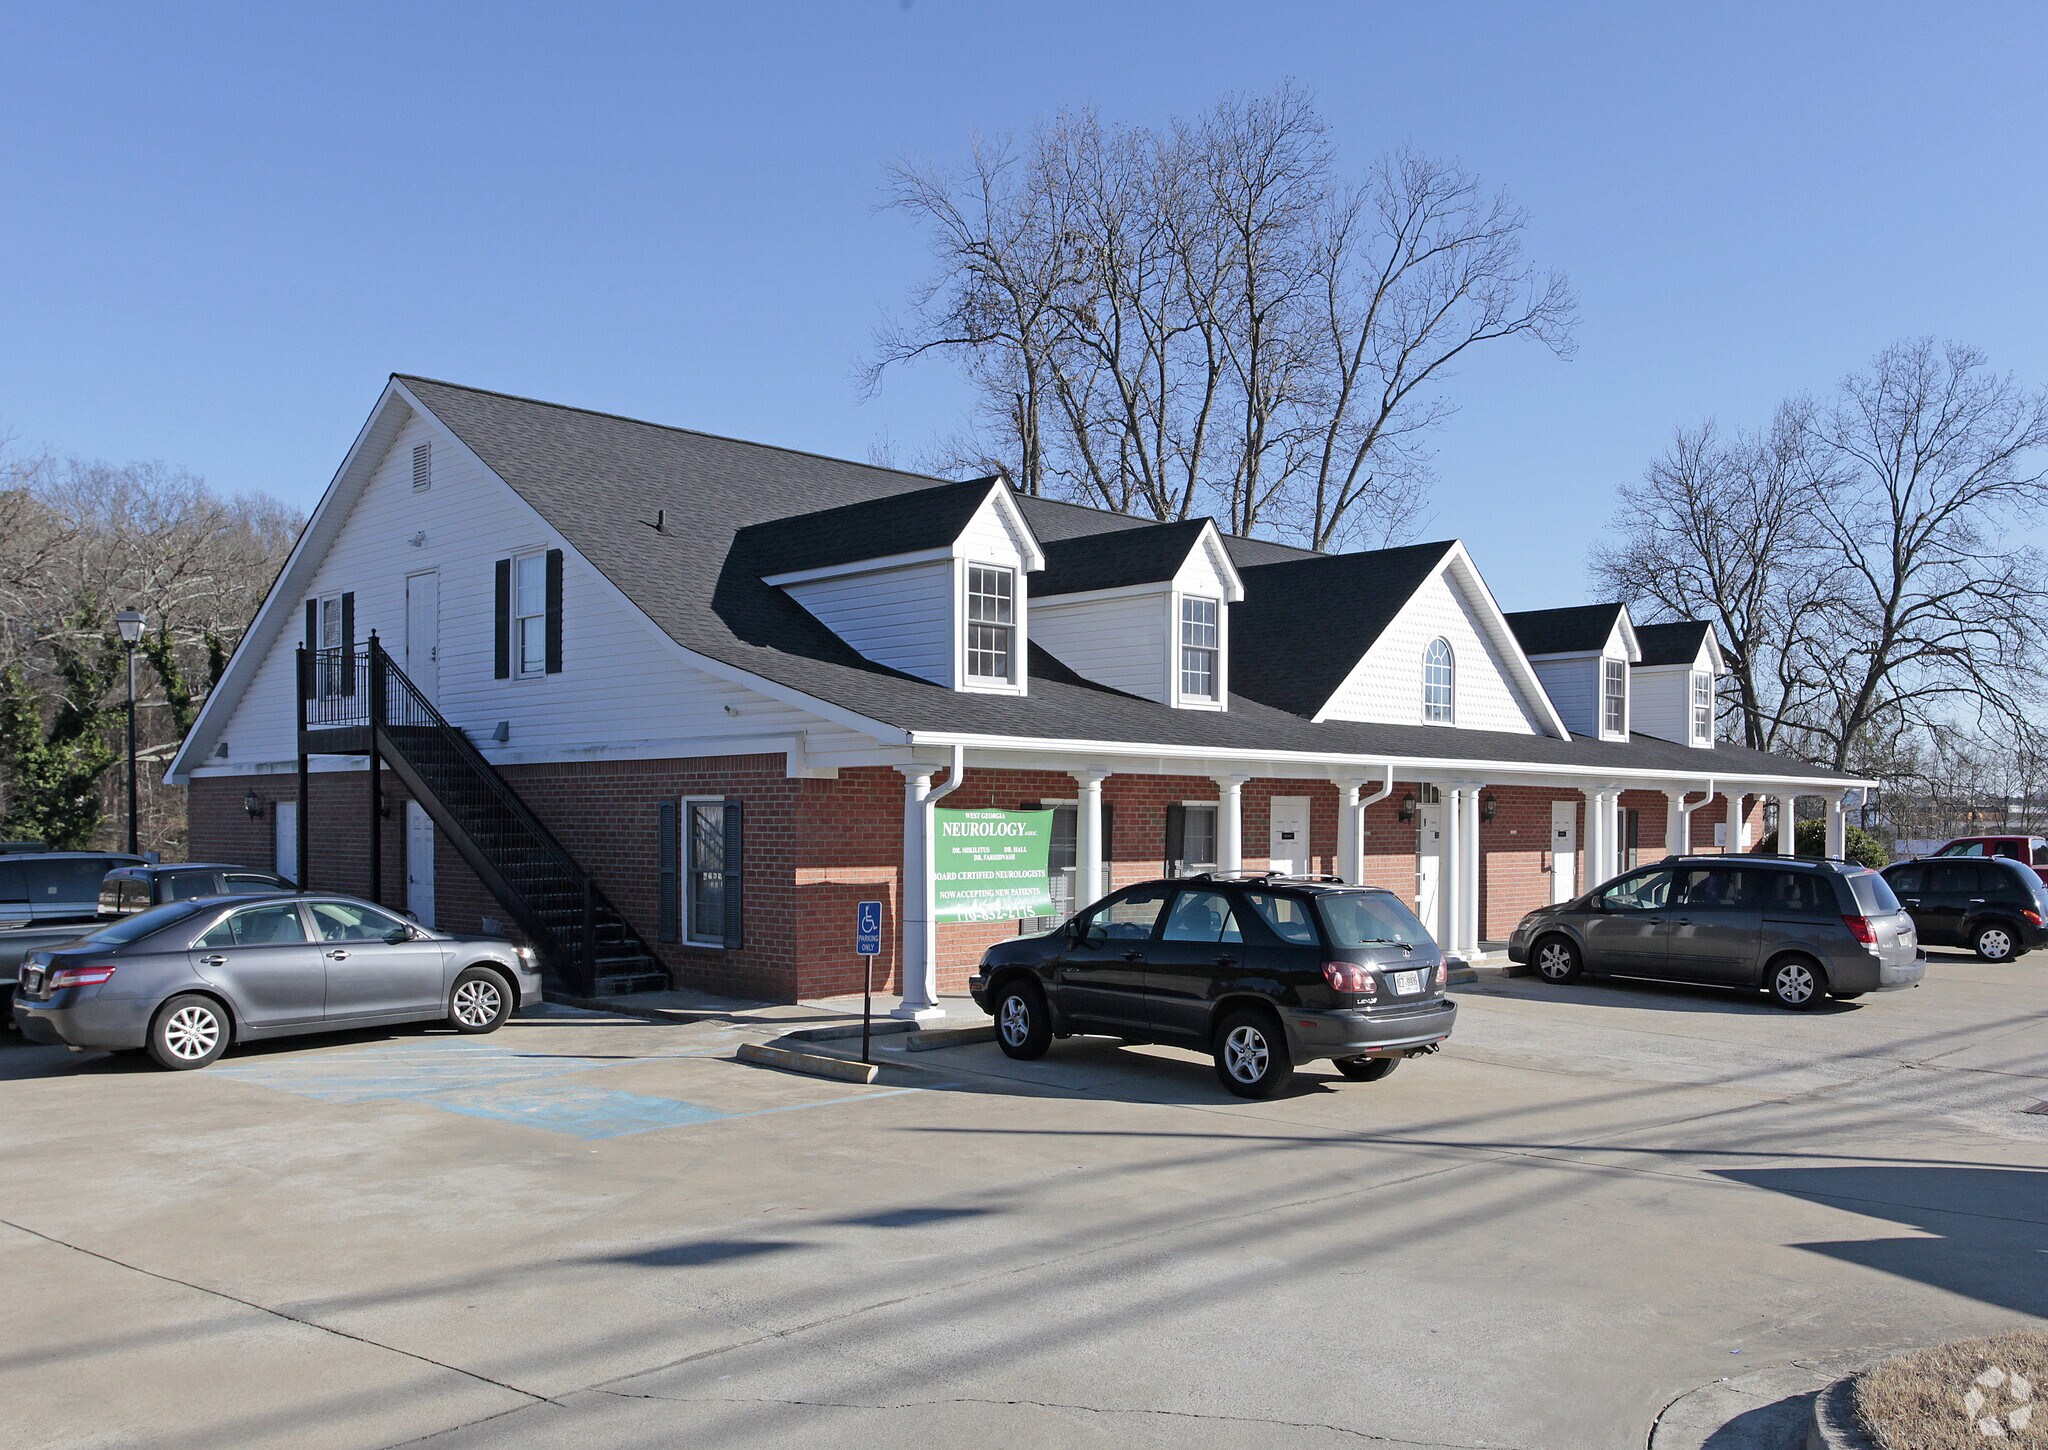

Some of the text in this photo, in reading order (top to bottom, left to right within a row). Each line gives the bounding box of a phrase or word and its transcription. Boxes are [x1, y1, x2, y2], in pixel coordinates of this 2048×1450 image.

[943, 822, 1026, 836] NEUROLOGY
[958, 870, 994, 880] CERTIFIED
[995, 869, 1046, 879] NEUROLOGISTS
[940, 887, 1040, 899] NOW ACCEPTING NEW PATIENTS
